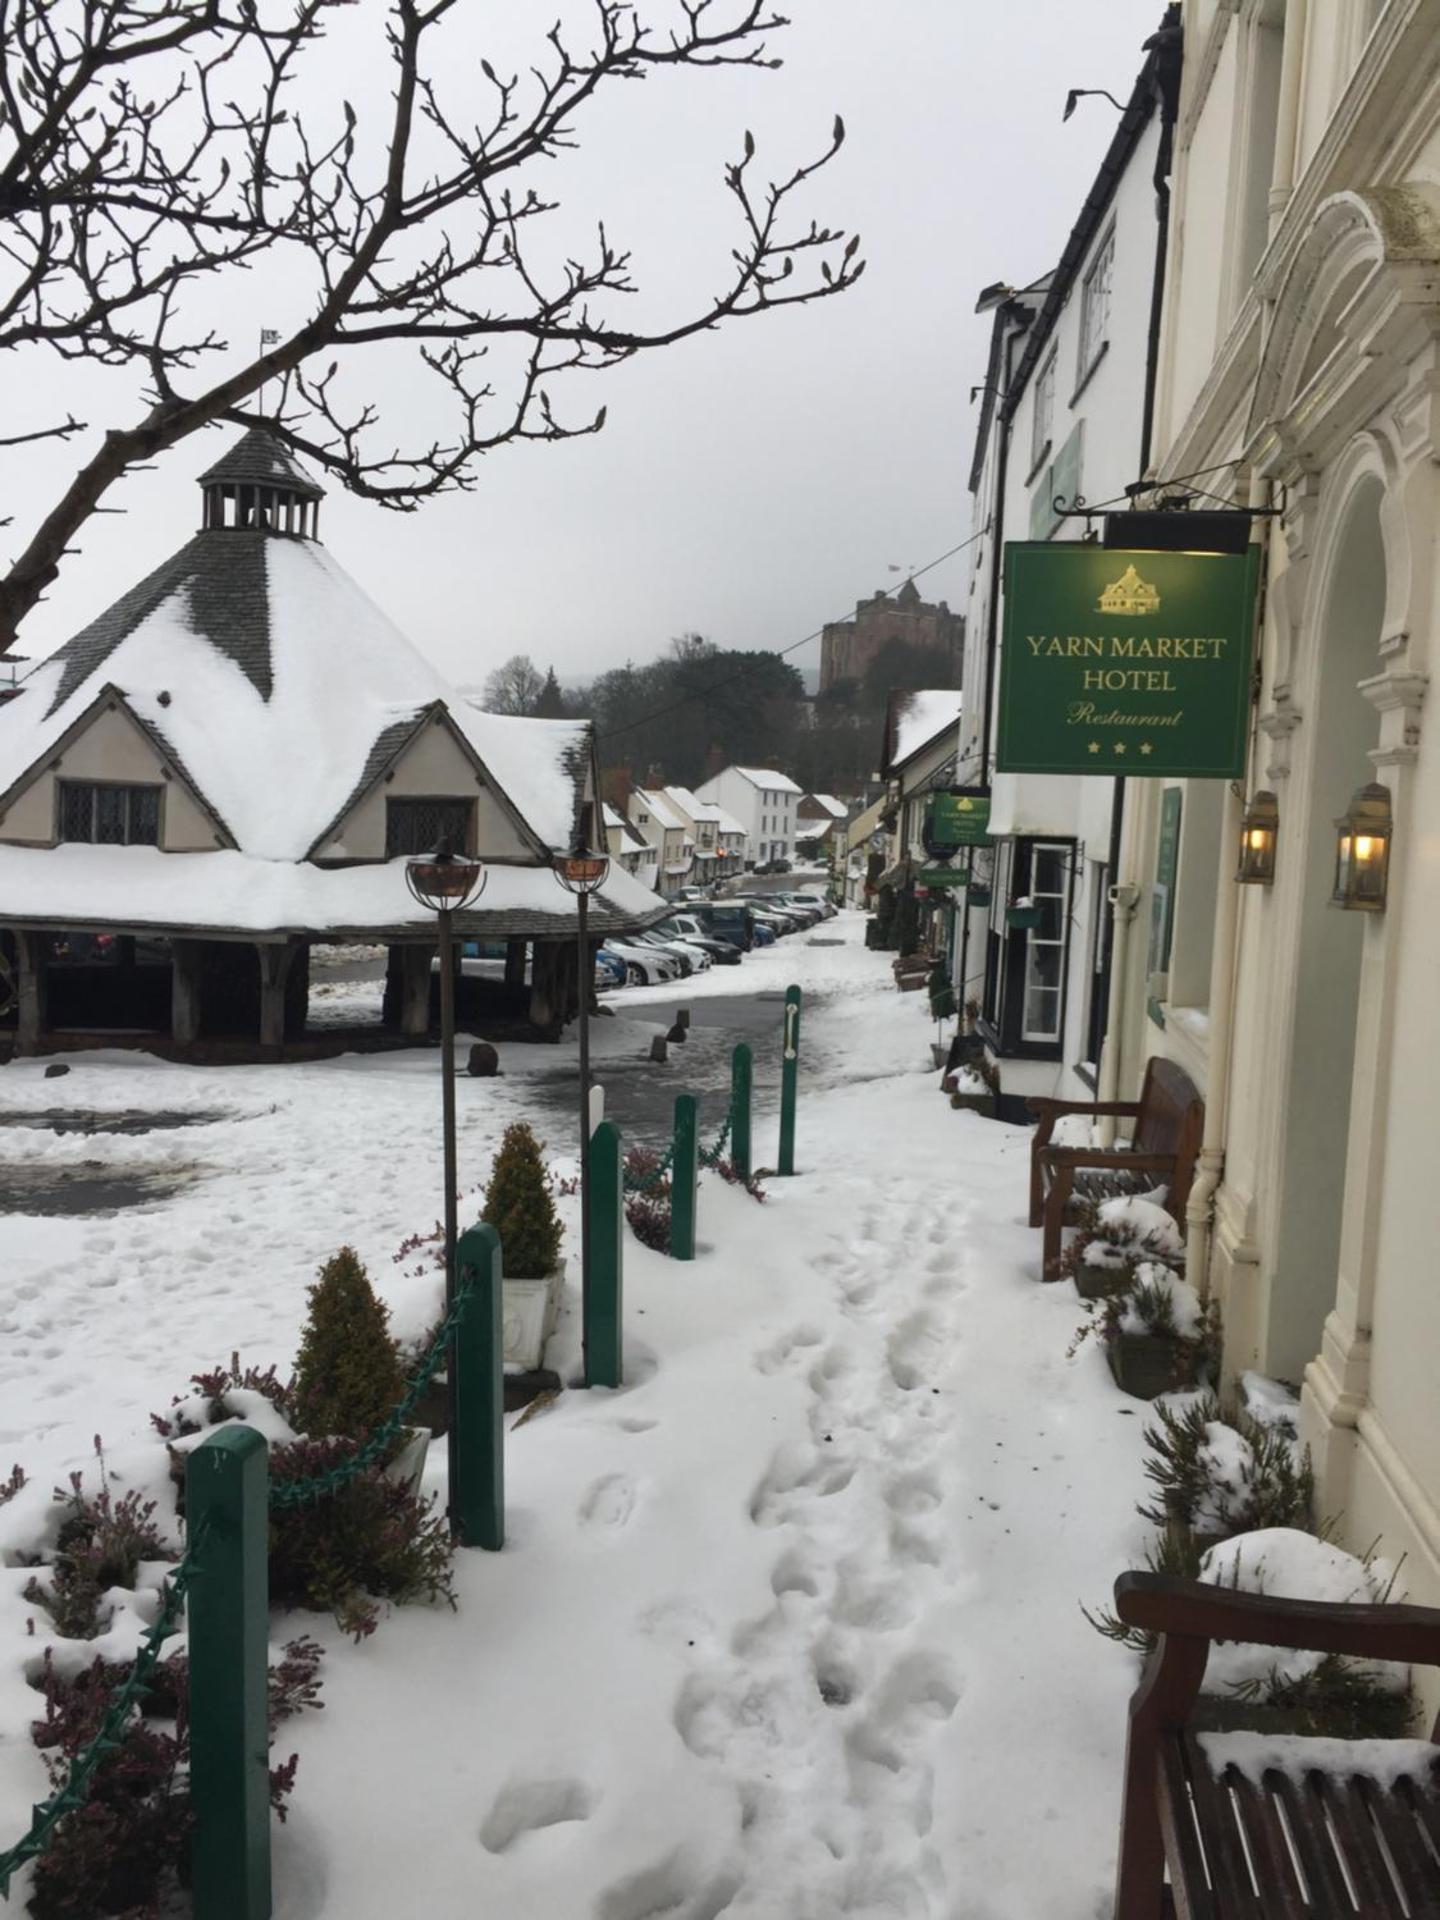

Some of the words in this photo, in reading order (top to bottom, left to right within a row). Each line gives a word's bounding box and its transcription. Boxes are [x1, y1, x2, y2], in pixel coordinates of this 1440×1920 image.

[1026, 636, 1104, 657] YARN
[1110, 637, 1228, 659] MARKET
[1082, 670, 1177, 692] HOTEL
[1066, 700, 1184, 727] Restaurant
